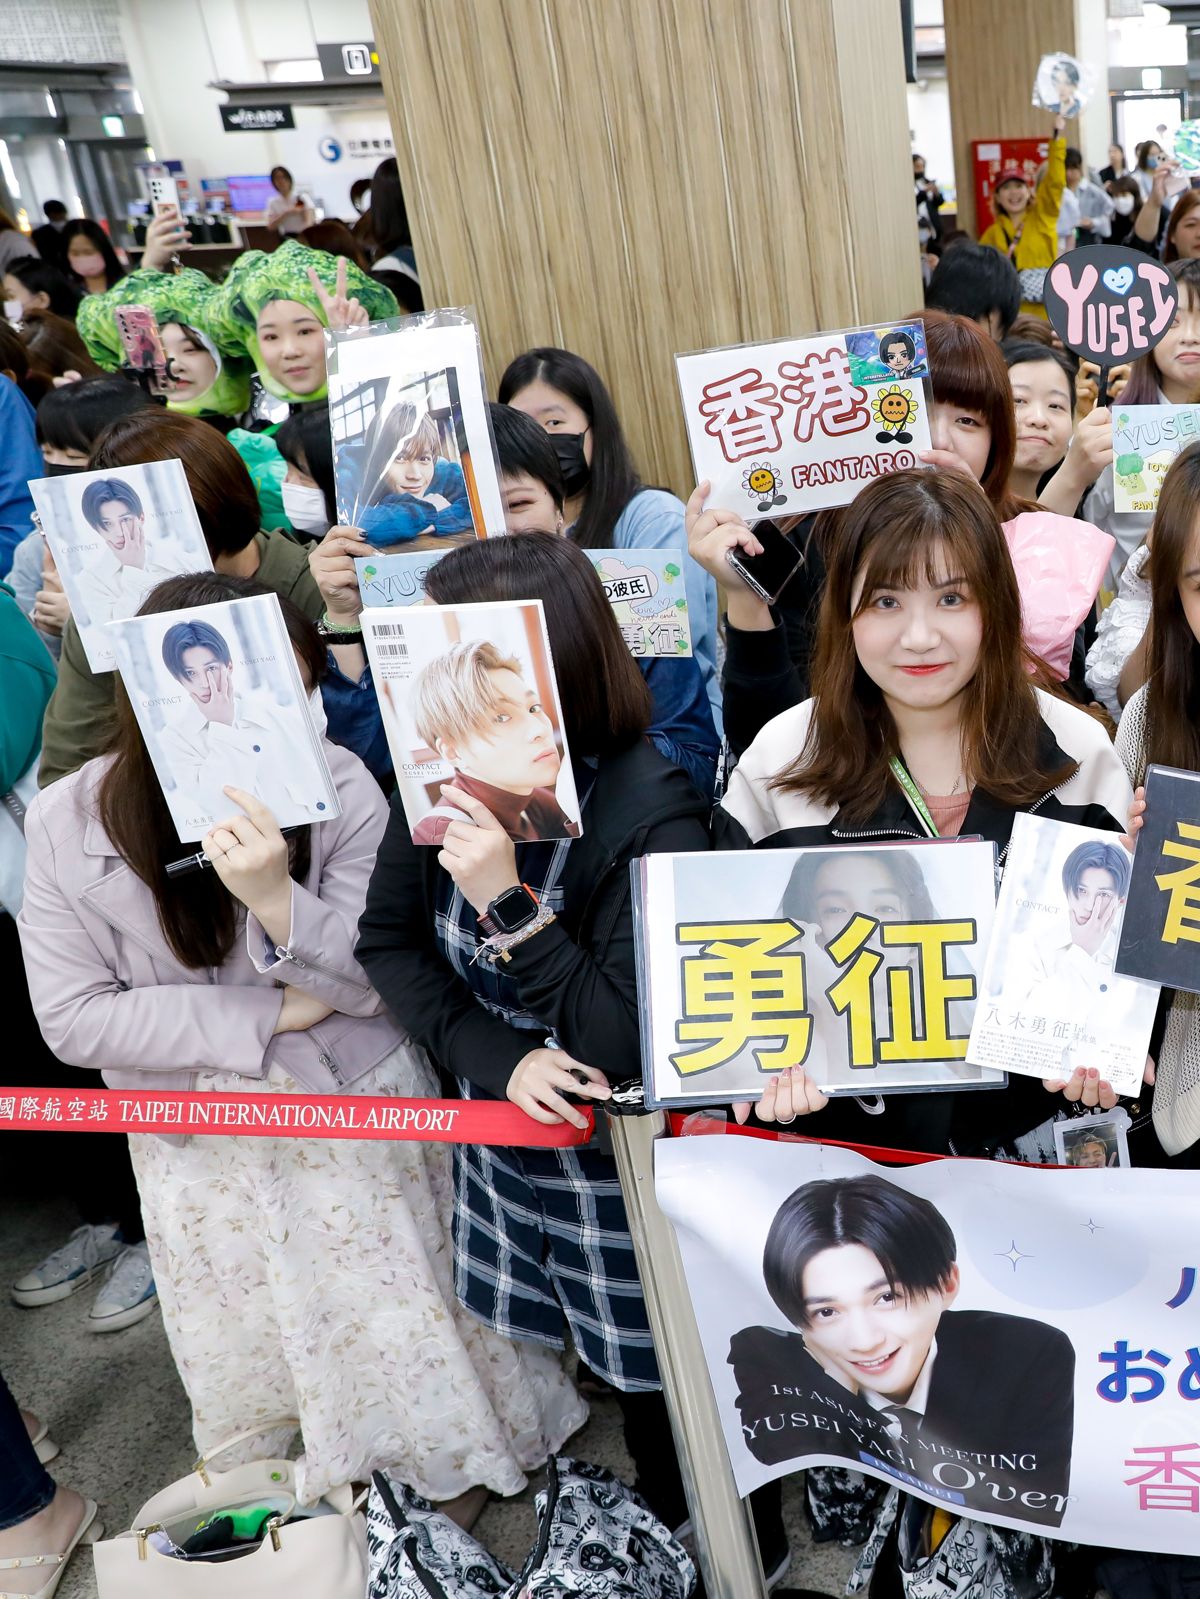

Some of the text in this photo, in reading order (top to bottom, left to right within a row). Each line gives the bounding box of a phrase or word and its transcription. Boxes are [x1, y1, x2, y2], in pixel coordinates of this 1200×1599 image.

[699, 348, 870, 463] 香港
[792, 450, 916, 489] FANTARO
[1132, 501, 1154, 511] FAN
[142, 695, 182, 708] CONTACT
[402, 763, 441, 771] CONTACT
[1016, 898, 1061, 914] CONTACT
[669, 913, 977, 1077] 勇征
[984, 1008, 1071, 1039] 八木勇征
[0, 1096, 459, 1131] 國際航空站 TAIPEI INTERNATIONAL AIRPORT
[742, 1412, 916, 1471] YUSEI YAGI
[770, 1384, 803, 1398] 1st
[917, 1437, 1037, 1472] MEETING
[931, 1463, 1081, 1513] O'ver
